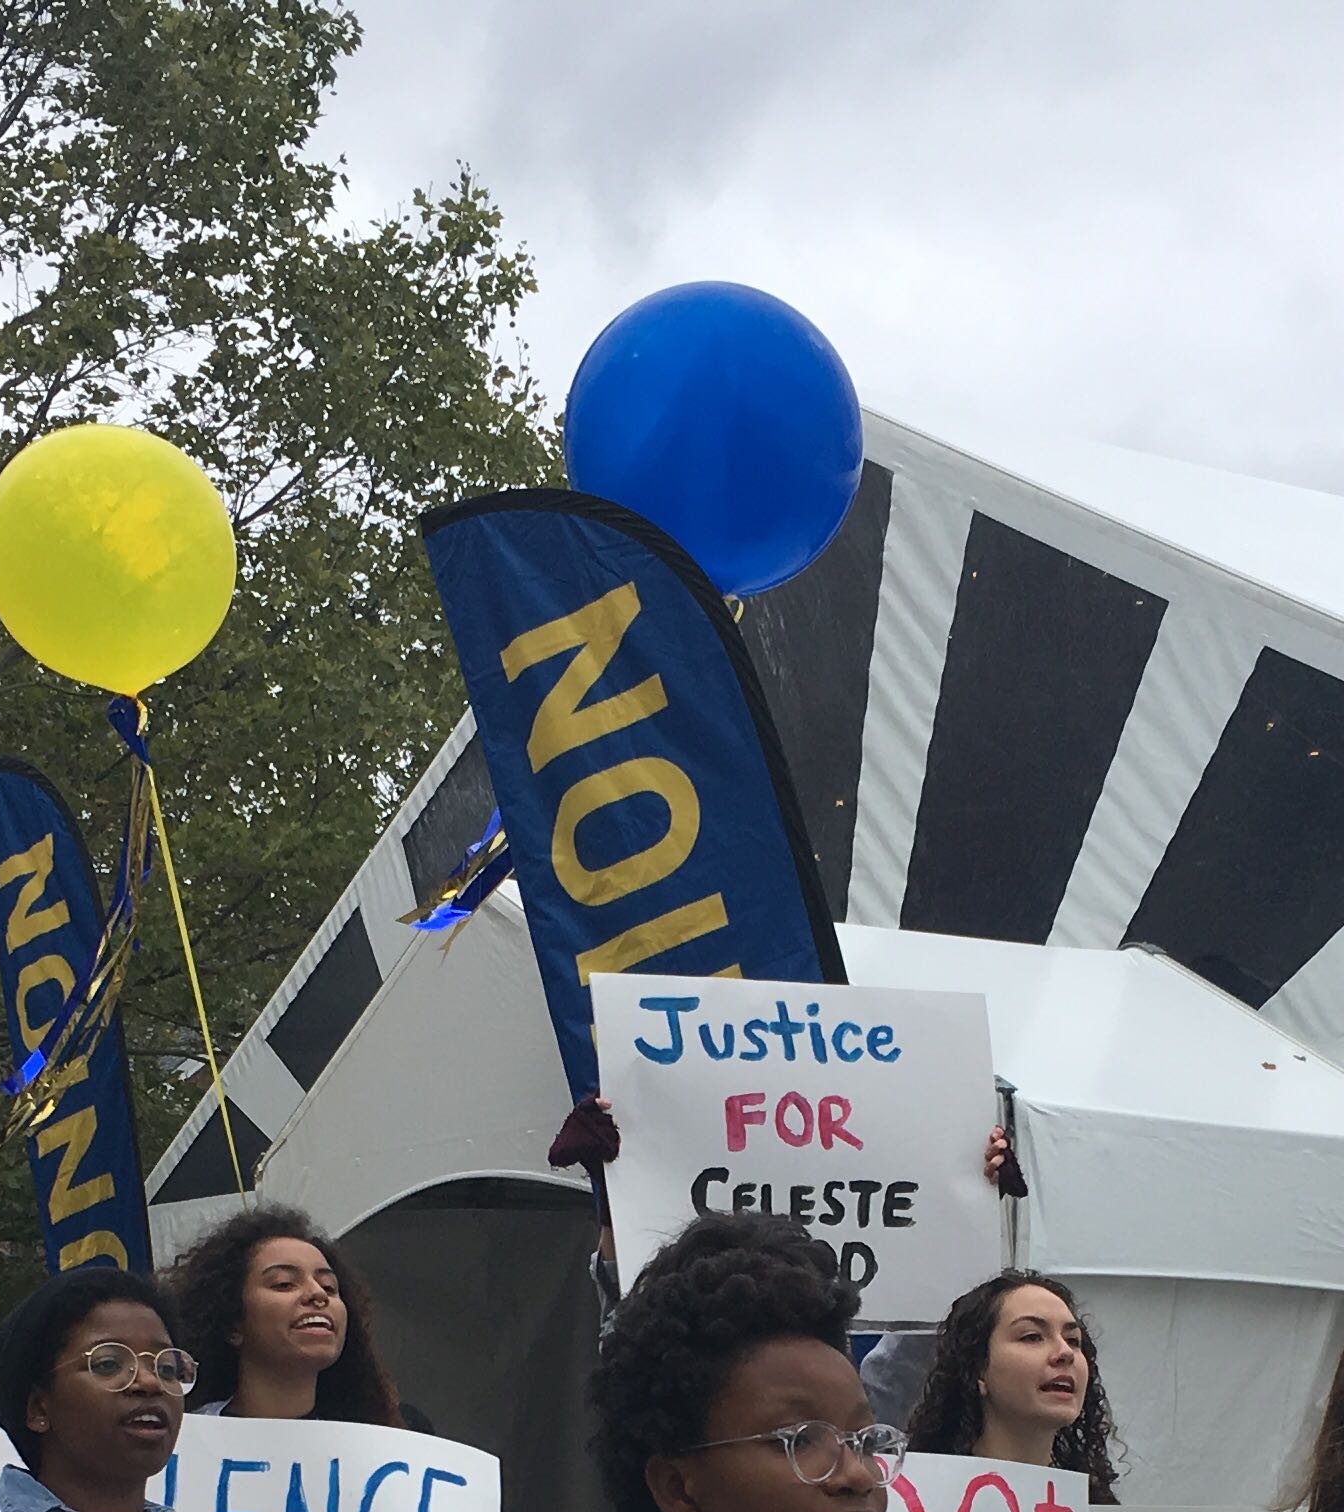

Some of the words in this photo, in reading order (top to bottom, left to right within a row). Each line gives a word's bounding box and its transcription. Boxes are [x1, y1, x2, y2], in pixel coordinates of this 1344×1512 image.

[633, 995, 903, 1065] Justice
[723, 1090, 865, 1153] FOR
[690, 1166, 920, 1230] CELESTE
